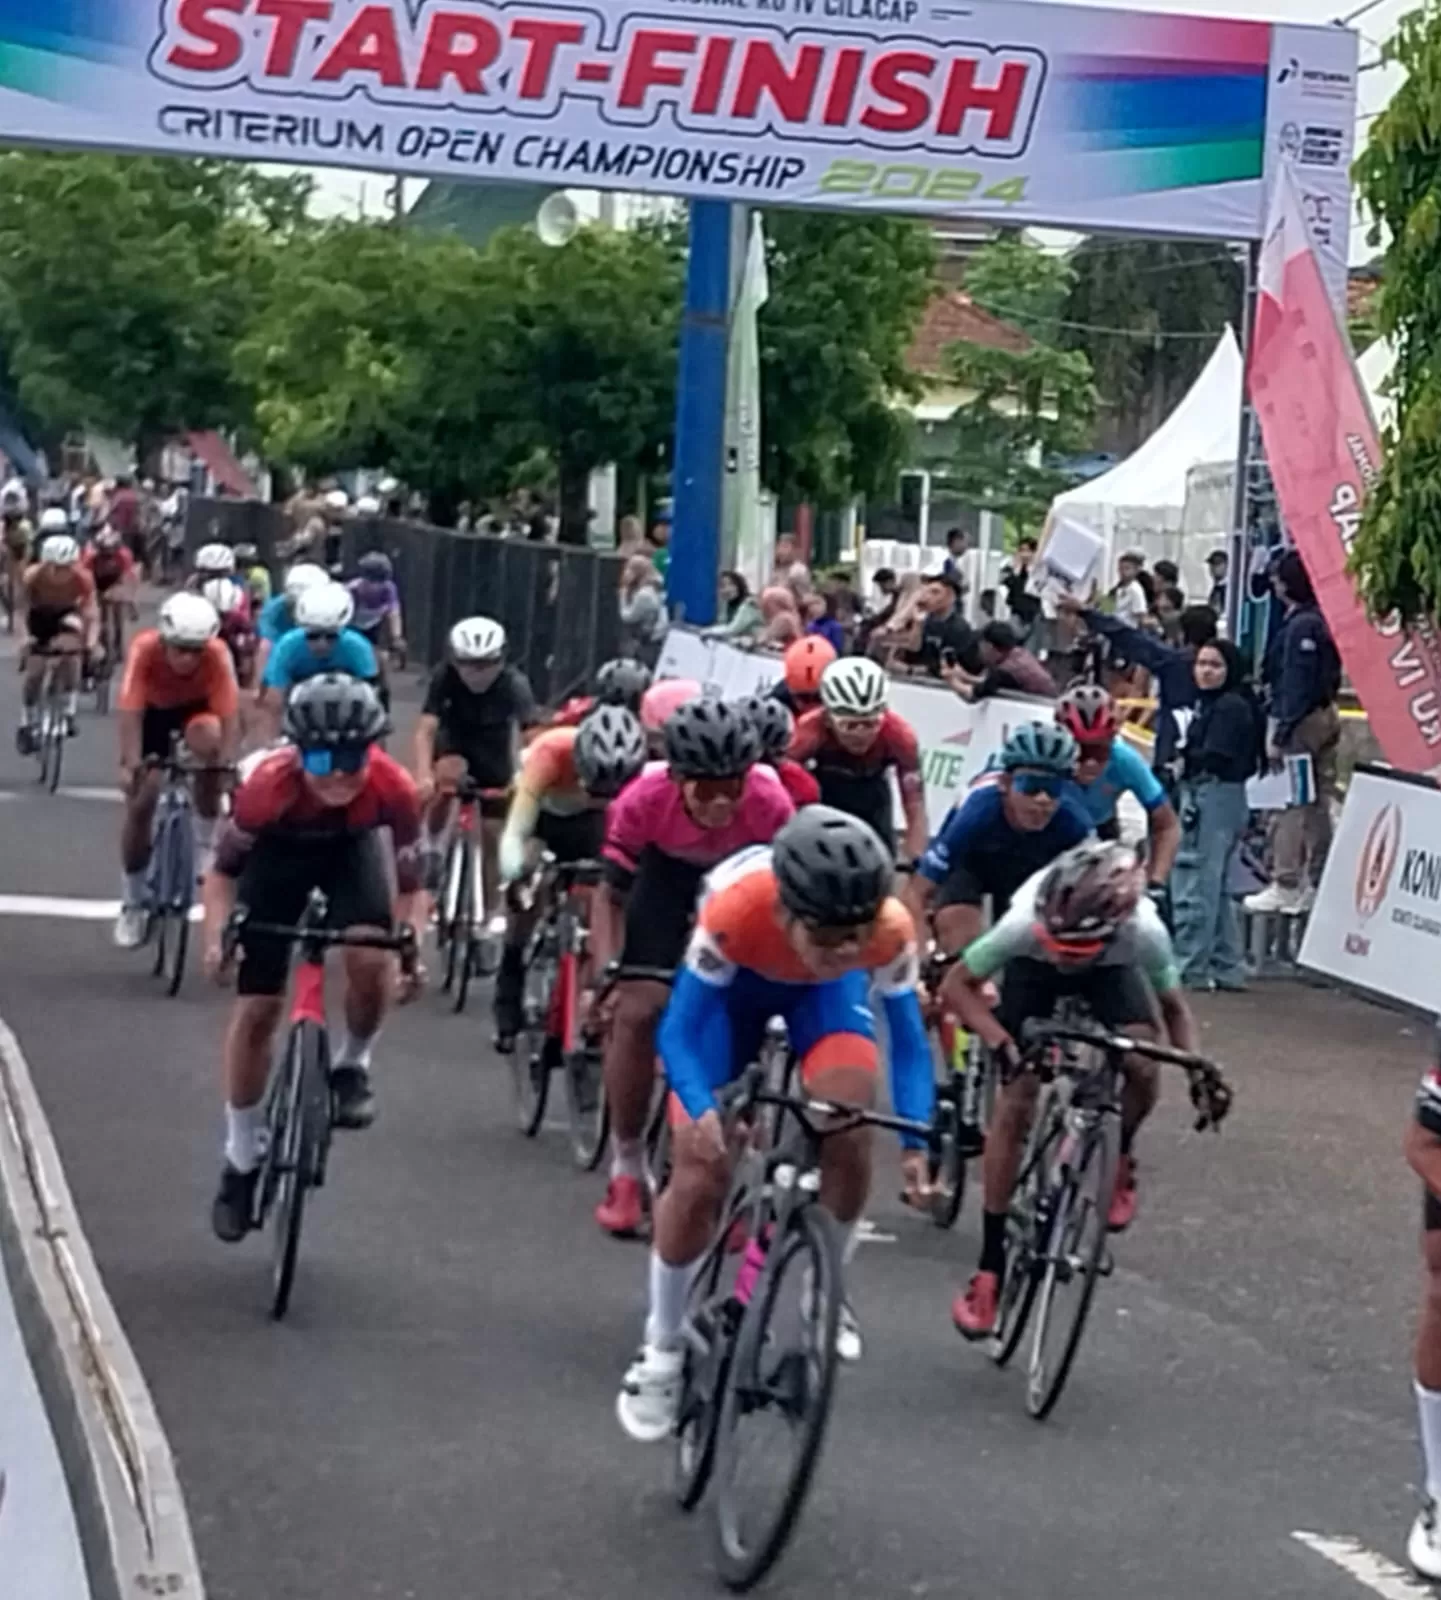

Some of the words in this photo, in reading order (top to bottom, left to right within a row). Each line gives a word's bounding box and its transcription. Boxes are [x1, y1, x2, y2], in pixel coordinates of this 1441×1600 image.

[824, 0, 919, 24] CILACAP
[165, 0, 1030, 140] START-FINISH
[157, 104, 384, 151] CRITERIUM
[397, 125, 503, 165] OPEN
[512, 134, 806, 191] CHAMPIONSHIP
[820, 159, 1029, 206] 2024
